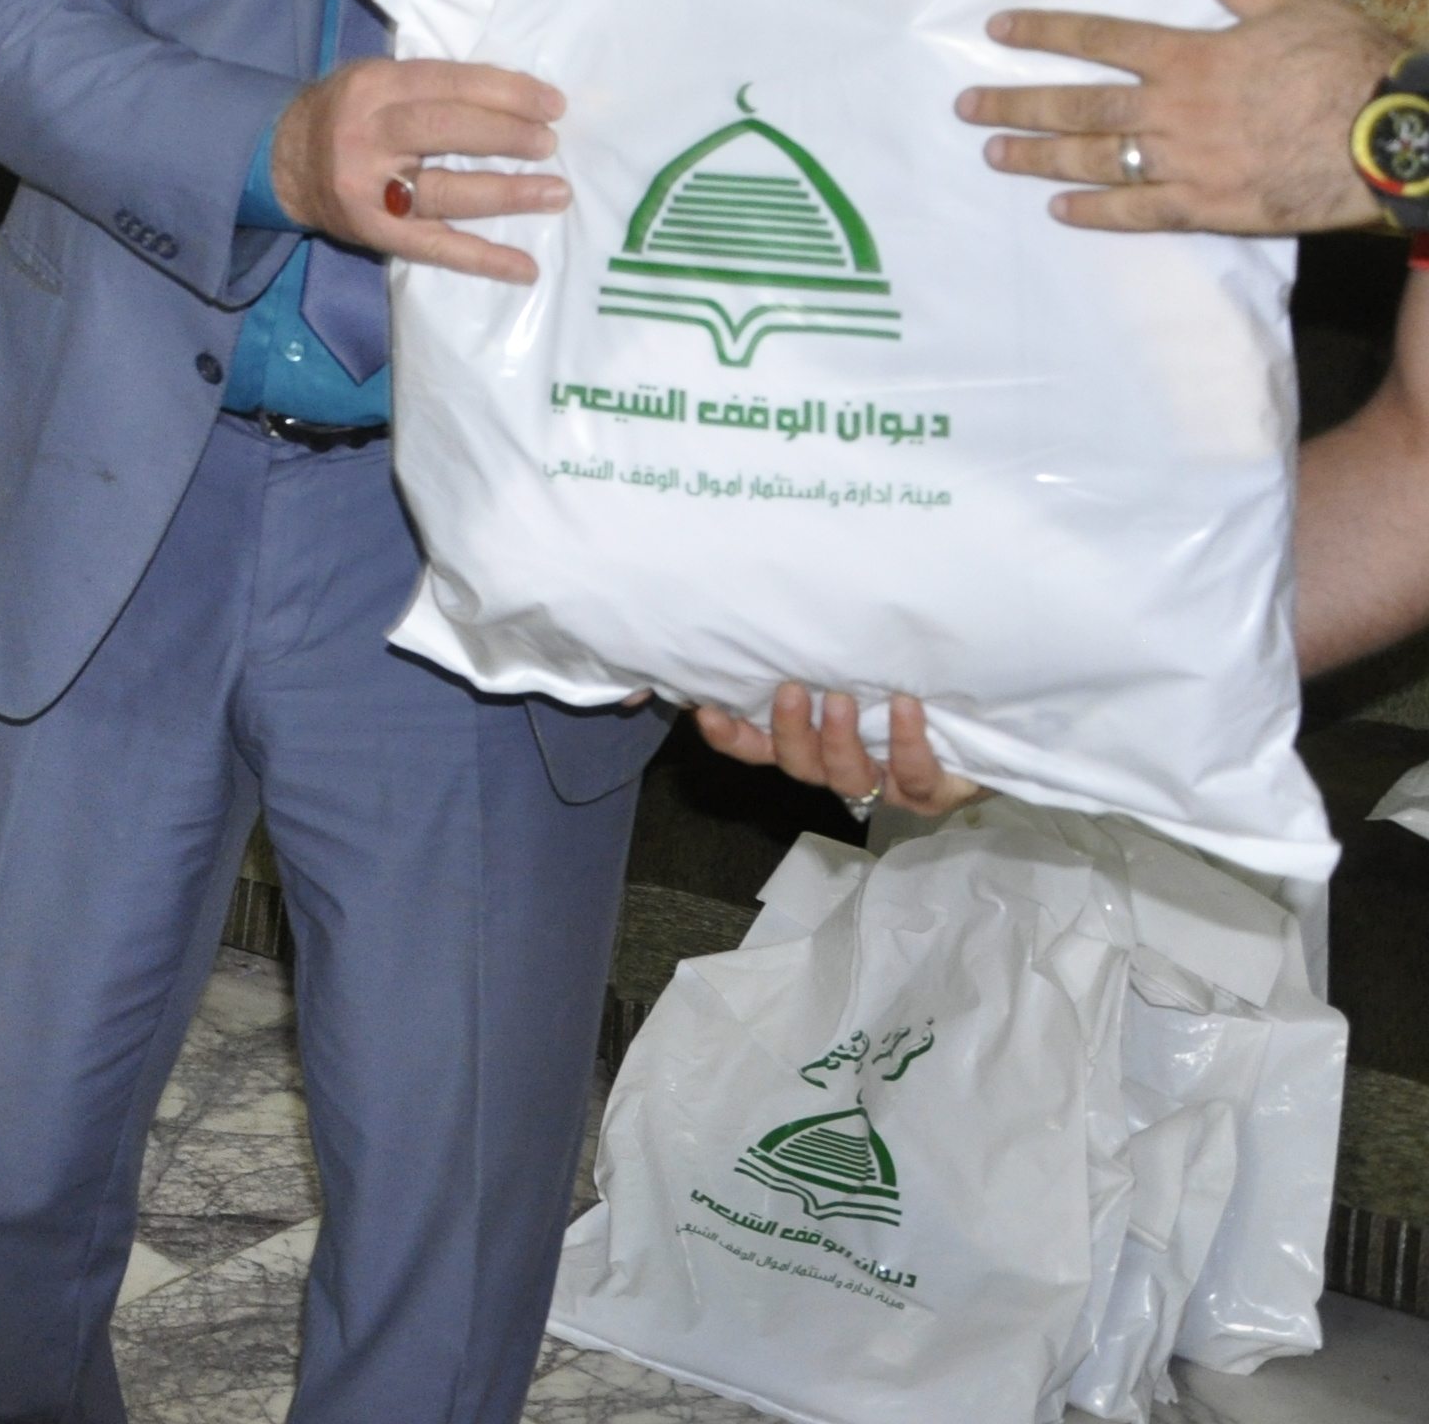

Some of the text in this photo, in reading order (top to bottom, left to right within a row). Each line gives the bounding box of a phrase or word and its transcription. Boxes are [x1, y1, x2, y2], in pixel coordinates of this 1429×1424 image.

[550, 381, 952, 446] ديوان الوقف الشيعي
[619, 463, 680, 493] الوقف
[690, 1188, 778, 1236] الشيعي
